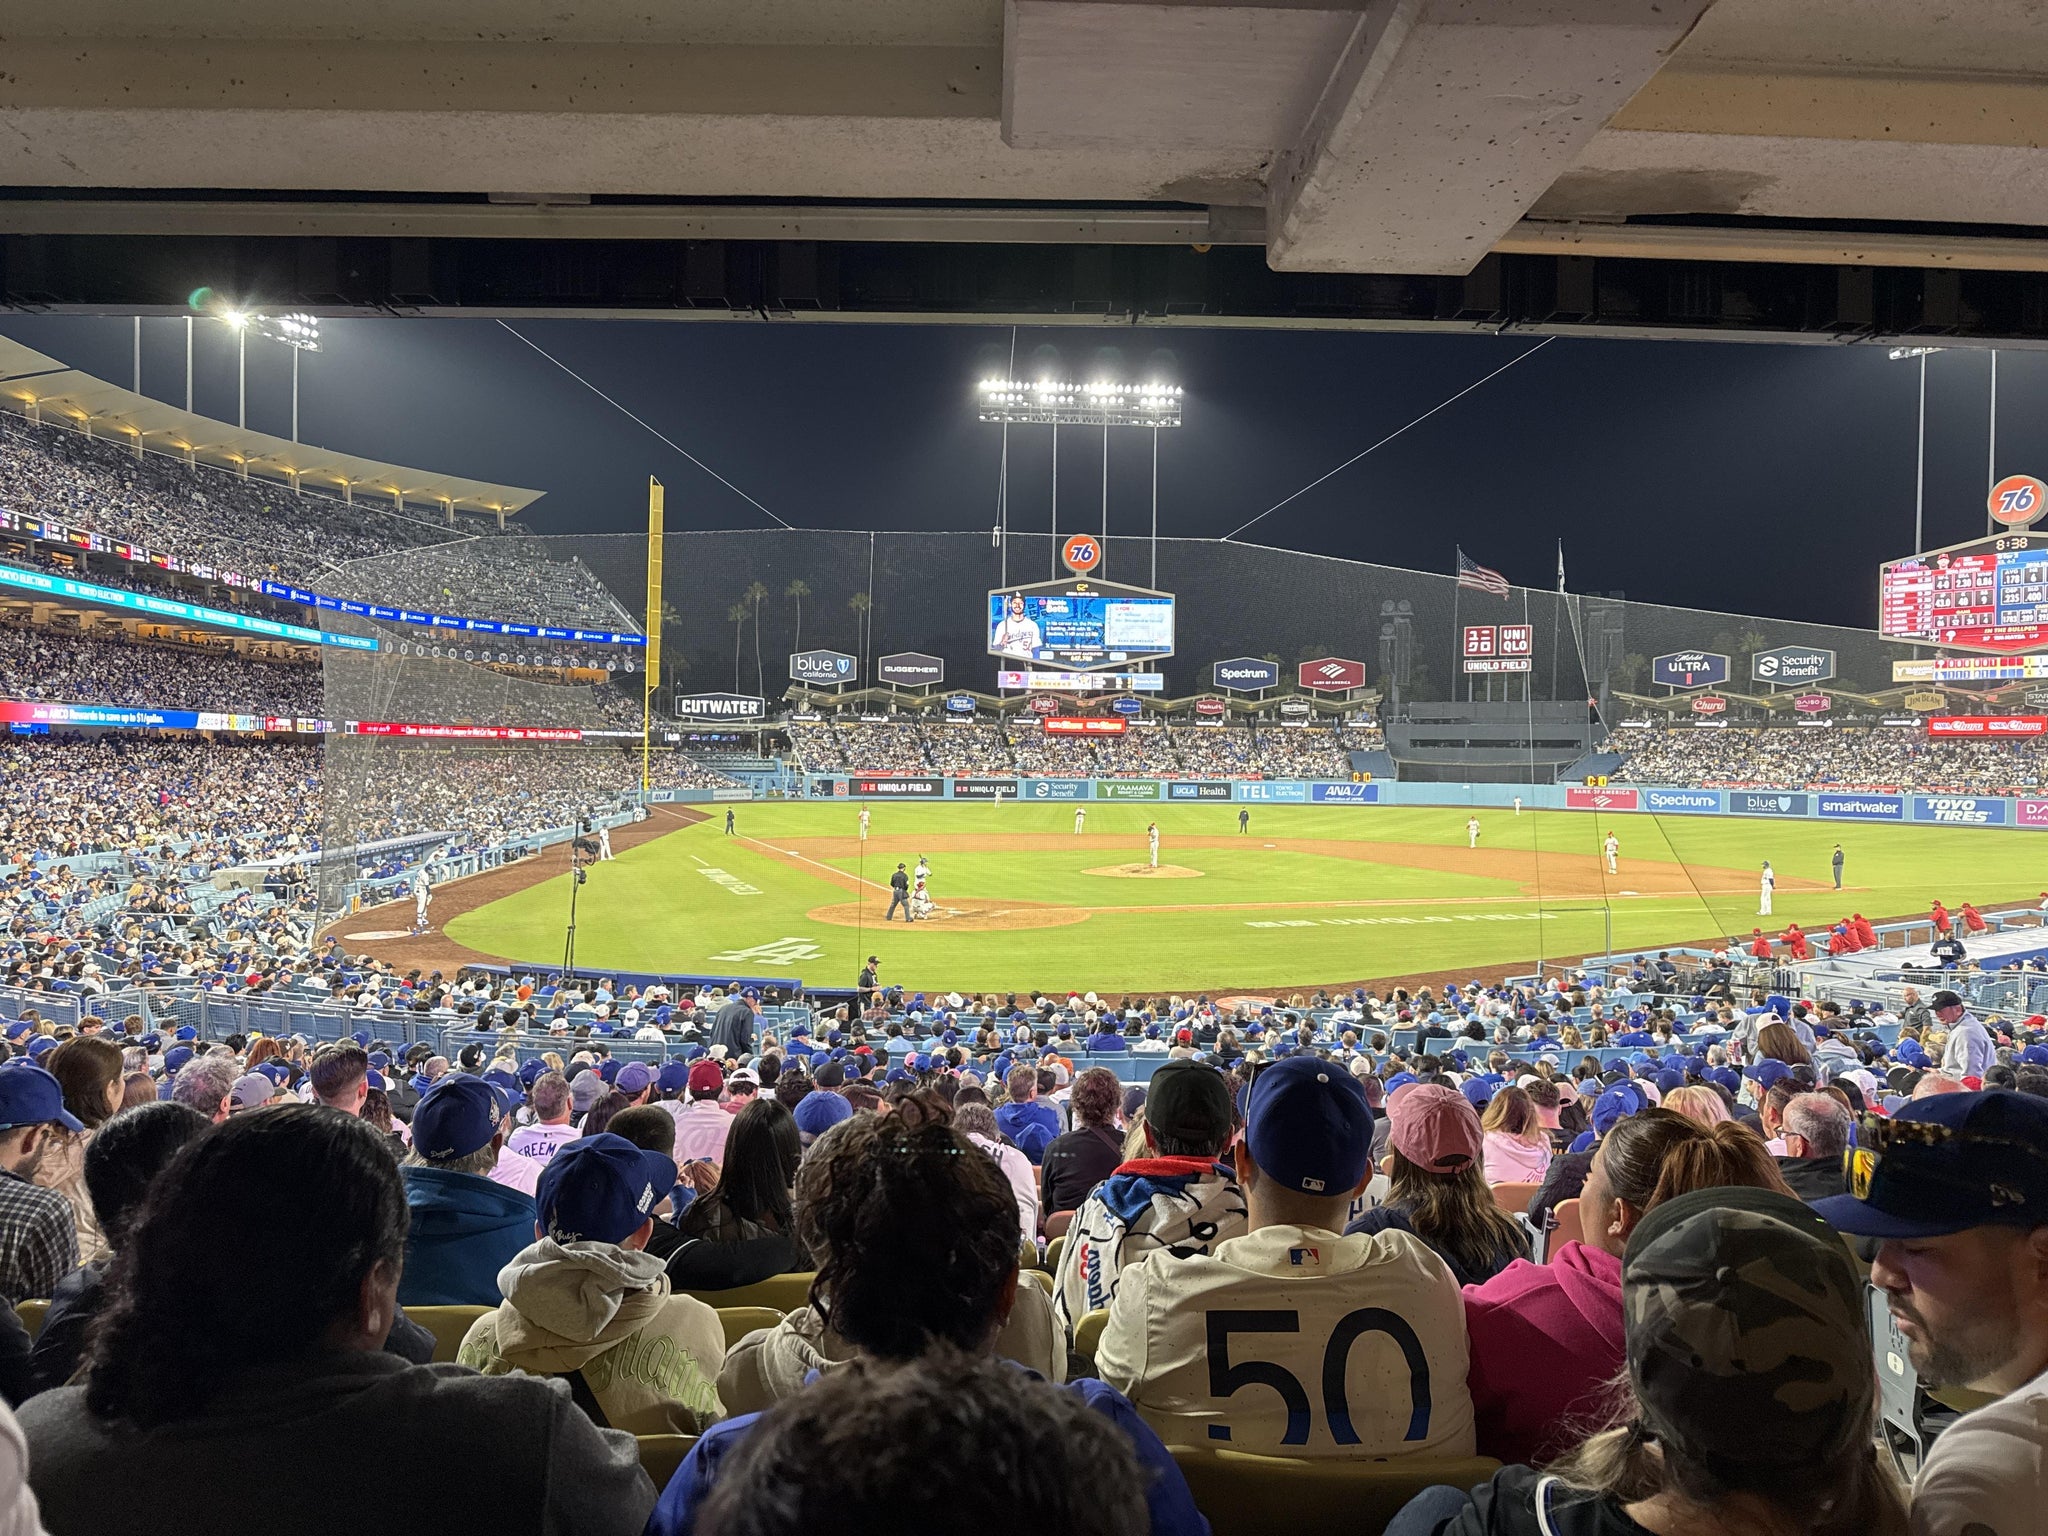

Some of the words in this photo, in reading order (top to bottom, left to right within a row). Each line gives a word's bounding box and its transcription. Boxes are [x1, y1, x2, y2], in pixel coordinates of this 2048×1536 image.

[2000, 485, 2035, 513] 76
[1996, 538, 2027, 550] 8:38
[1070, 544, 1094, 562] 76
[2025, 592, 2041, 601] .400
[1504, 630, 1525, 639] UNI
[1504, 641, 1527, 652] QLO
[798, 656, 833, 671] blue
[1468, 662, 1499, 671] UNIQLO
[1669, 661, 1710, 672] ULTRA
[1782, 656, 1824, 667] Security
[1221, 669, 1268, 680] Spectrum
[1783, 666, 1818, 676] Benefit
[1693, 700, 1724, 711] Churu
[1908, 696, 1920, 706] JIM
[682, 700, 758, 714] CUTWATER
[32, 707, 48, 718] Join
[49, 708, 68, 720] ARCO
[69, 709, 97, 721] Rewards
[99, 711, 105, 721] to
[106, 713, 120, 722] save
[122, 713, 129, 724] up
[130, 712, 136, 722] to
[878, 783, 906, 792] UNIQLO
[908, 783, 932, 792] FIELD
[1051, 783, 1077, 792] Security
[1200, 787, 1226, 796] Health
[1240, 786, 1270, 798] TEL
[1325, 786, 1350, 796] ANA
[1650, 794, 1712, 809] Spectrum
[1748, 796, 1776, 807] blue
[1926, 799, 1976, 810] TOYO
[1823, 802, 1898, 814] smartwater
[1934, 810, 1988, 822] TIRES
[1206, 1308, 1431, 1446] 50
